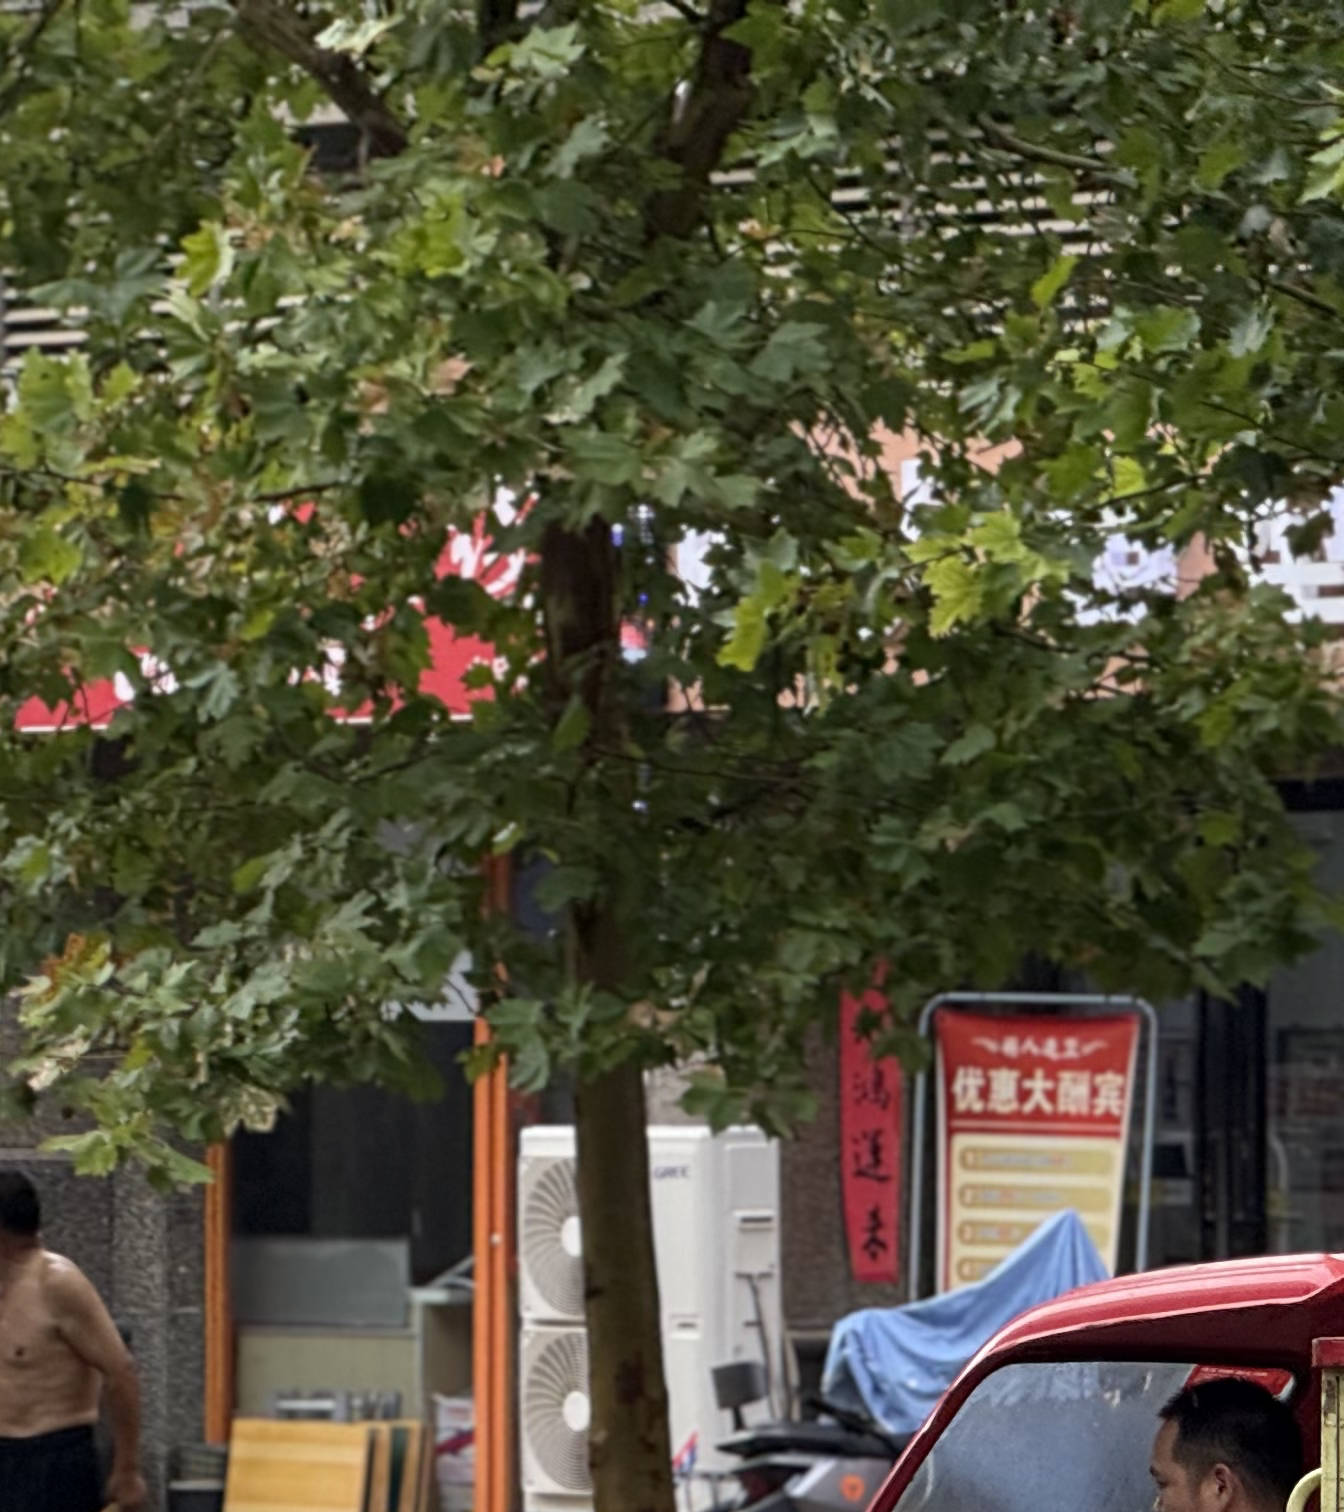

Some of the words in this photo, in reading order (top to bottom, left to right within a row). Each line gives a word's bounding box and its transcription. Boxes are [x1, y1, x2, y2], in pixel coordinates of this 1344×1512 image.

[952, 1066, 1124, 1117] 优惠大酬宾
